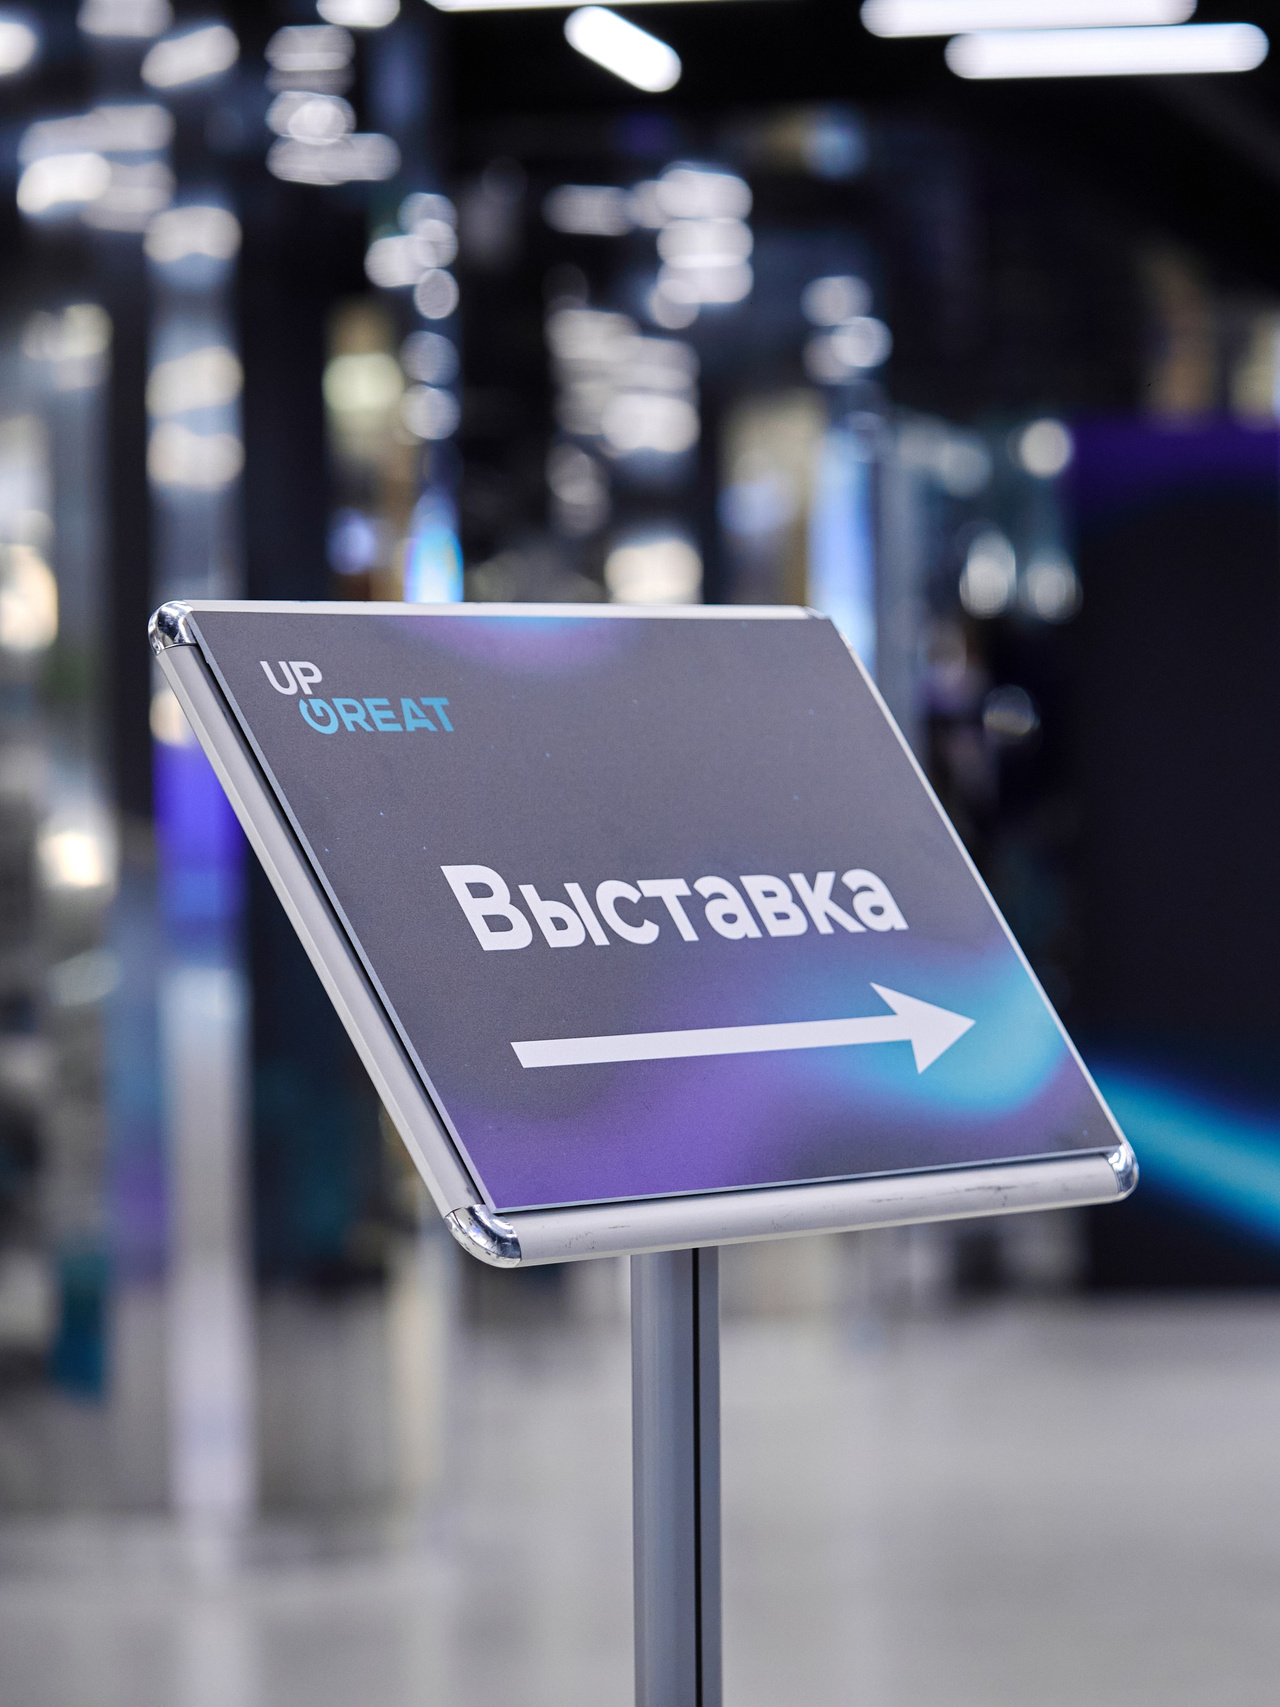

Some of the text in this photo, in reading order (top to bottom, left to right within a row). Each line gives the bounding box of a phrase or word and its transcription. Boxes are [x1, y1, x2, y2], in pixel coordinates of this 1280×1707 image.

[260, 661, 322, 695] UP
[299, 697, 454, 734] GREAT
[440, 864, 908, 951] Выставка
